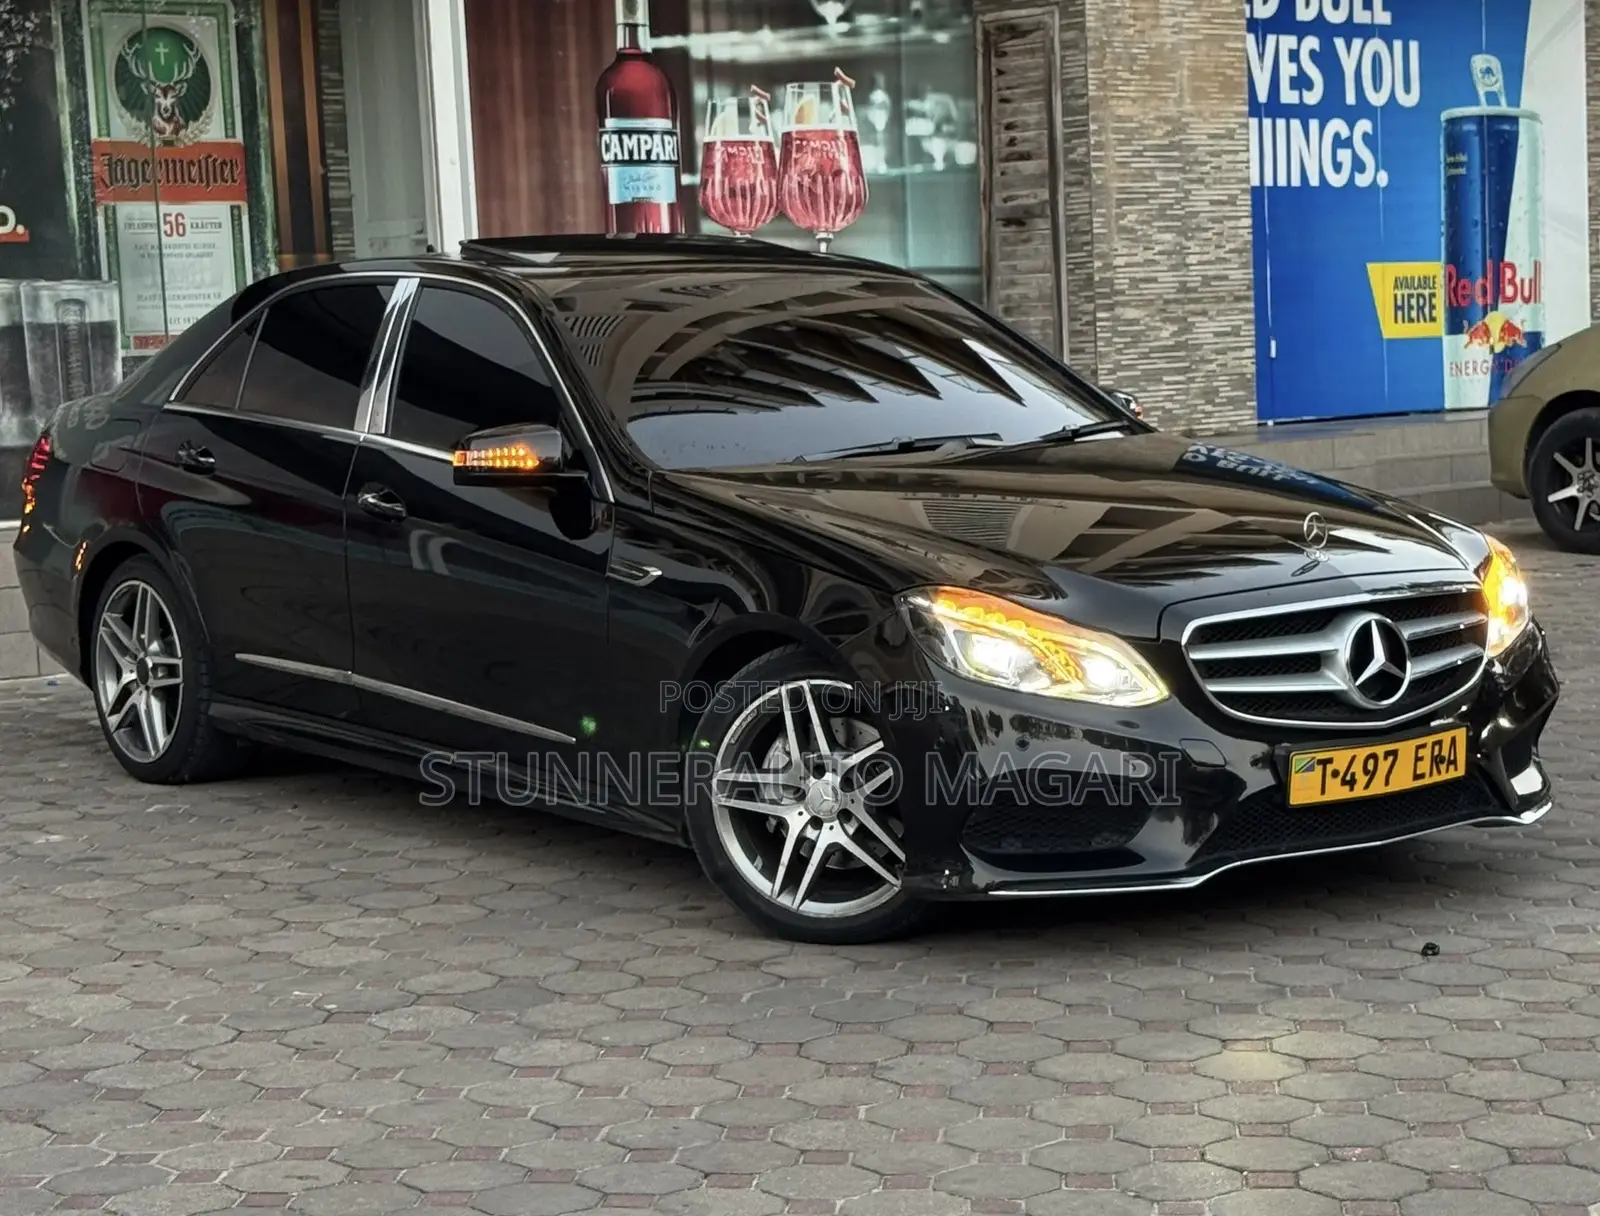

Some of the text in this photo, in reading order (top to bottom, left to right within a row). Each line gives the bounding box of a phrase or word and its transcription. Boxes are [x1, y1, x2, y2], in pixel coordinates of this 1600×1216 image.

[1333, 37, 1421, 108] YOU
[601, 133, 678, 162] CAMPARI
[163, 212, 186, 237] 56
[1393, 275, 1437, 290] AVAILABLE
[1445, 260, 1541, 306] Red Bull
[1393, 293, 1437, 324] HERE
[1412, 735, 1458, 781] ERA
